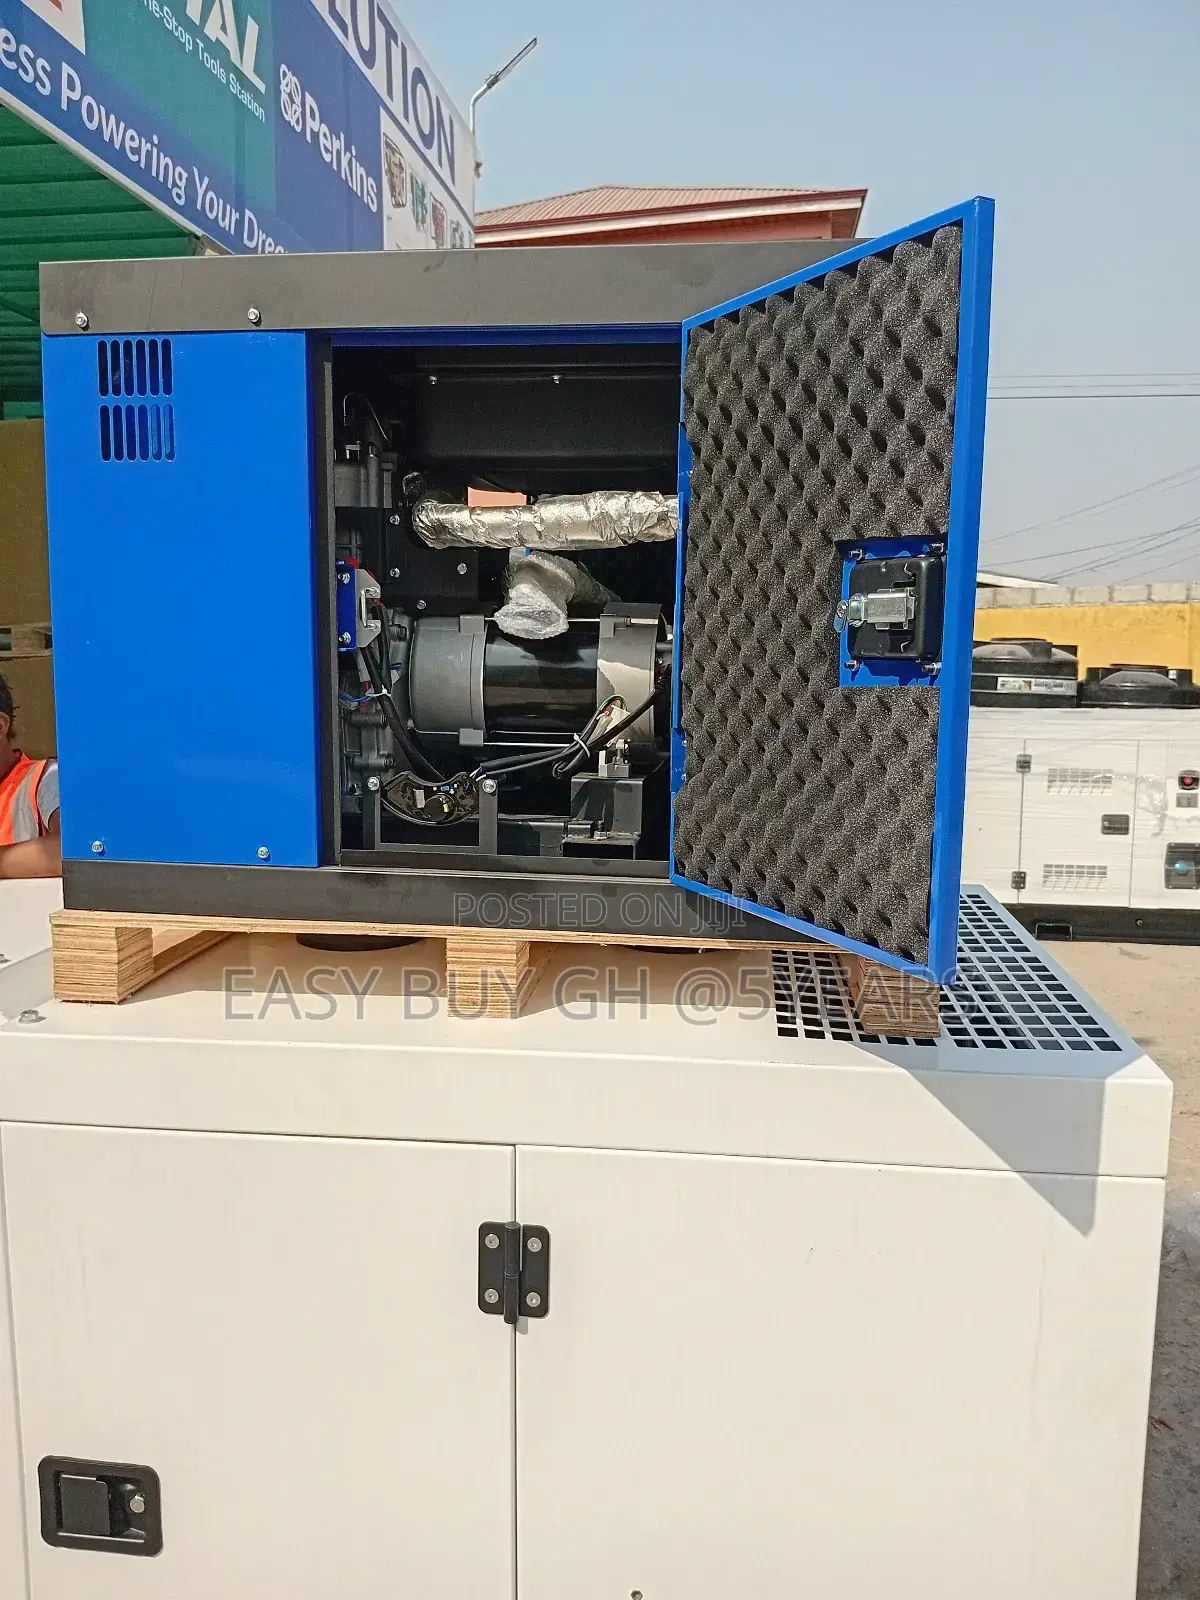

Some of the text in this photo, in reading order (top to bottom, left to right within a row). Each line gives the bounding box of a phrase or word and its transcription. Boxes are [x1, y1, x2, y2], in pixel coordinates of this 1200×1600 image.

[195, 38, 227, 84] Tools
[229, 73, 265, 123] Station
[60, 61, 189, 206] Powering
[192, 166, 240, 236] Your
[304, 91, 378, 213] Perkins
